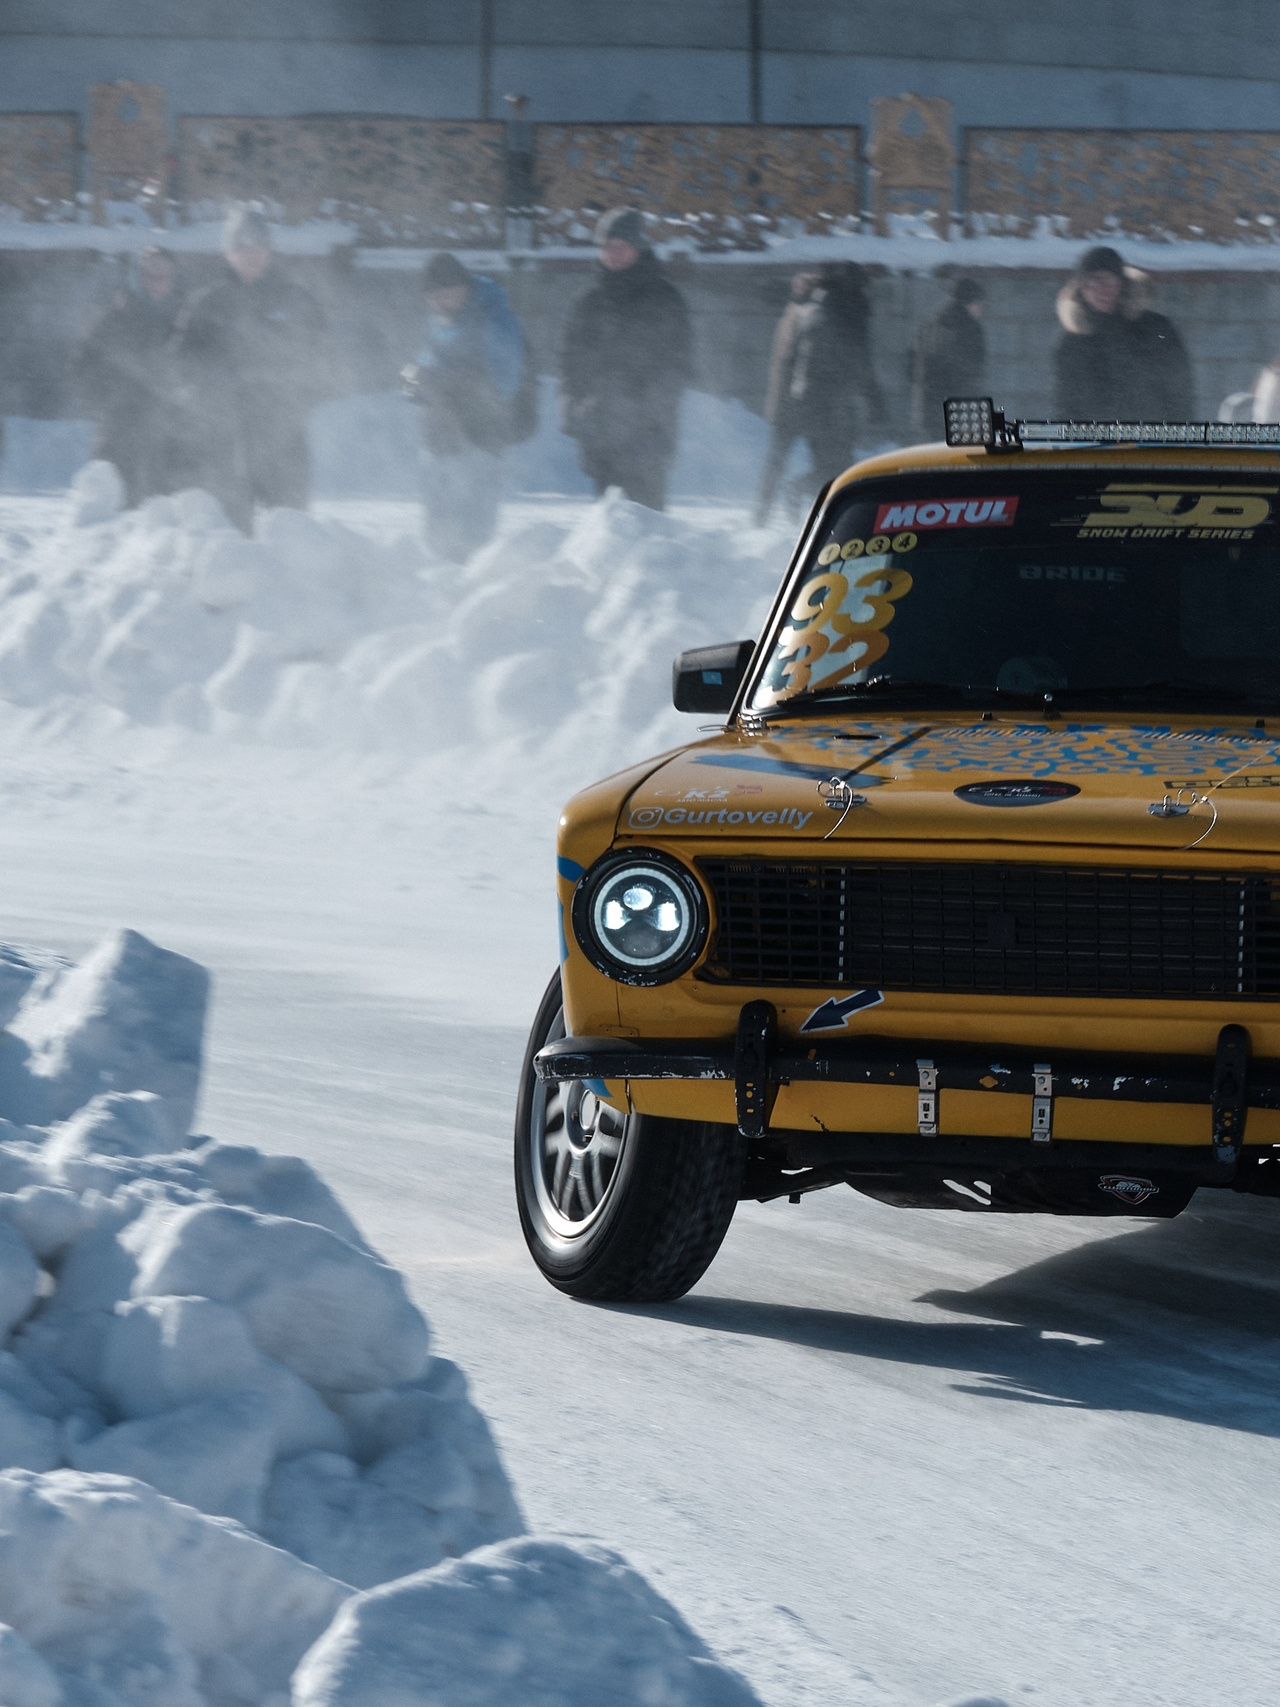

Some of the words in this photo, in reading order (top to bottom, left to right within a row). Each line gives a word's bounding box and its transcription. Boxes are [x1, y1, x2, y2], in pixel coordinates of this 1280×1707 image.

[880, 501, 1009, 529] MOTUL
[1077, 528, 1128, 539] SNOW
[1130, 528, 1184, 539] DRIFT
[1187, 529, 1255, 540] SERIES
[1019, 564, 1128, 582] BRIDE
[778, 568, 913, 646] 93
[752, 630, 889, 709] 32
[664, 807, 813, 830] Gurtovelly
